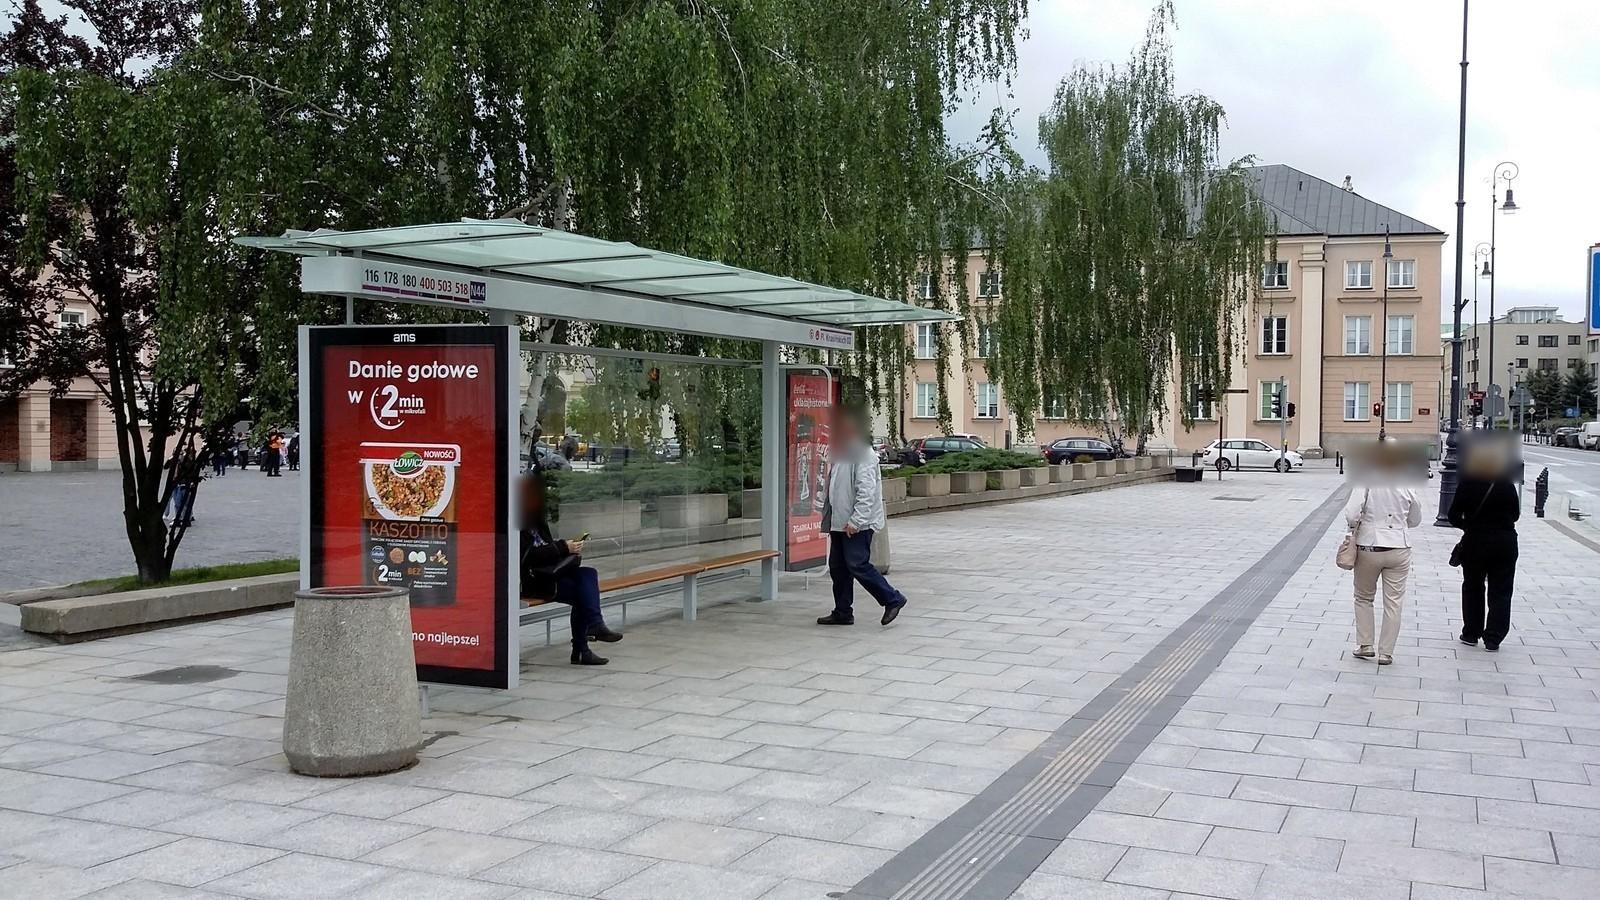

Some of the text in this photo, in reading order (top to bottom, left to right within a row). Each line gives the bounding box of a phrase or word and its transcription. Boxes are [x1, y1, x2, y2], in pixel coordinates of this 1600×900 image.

[364, 268, 485, 298] 116 178 180 400 503 518 N44
[393, 332, 416, 343] ams
[348, 360, 479, 383] Danie gotowe
[348, 384, 424, 418] w 2 min
[370, 521, 448, 540] KASZOTTO
[378, 564, 388, 582] 2
[428, 632, 480, 647] najlepsze!
